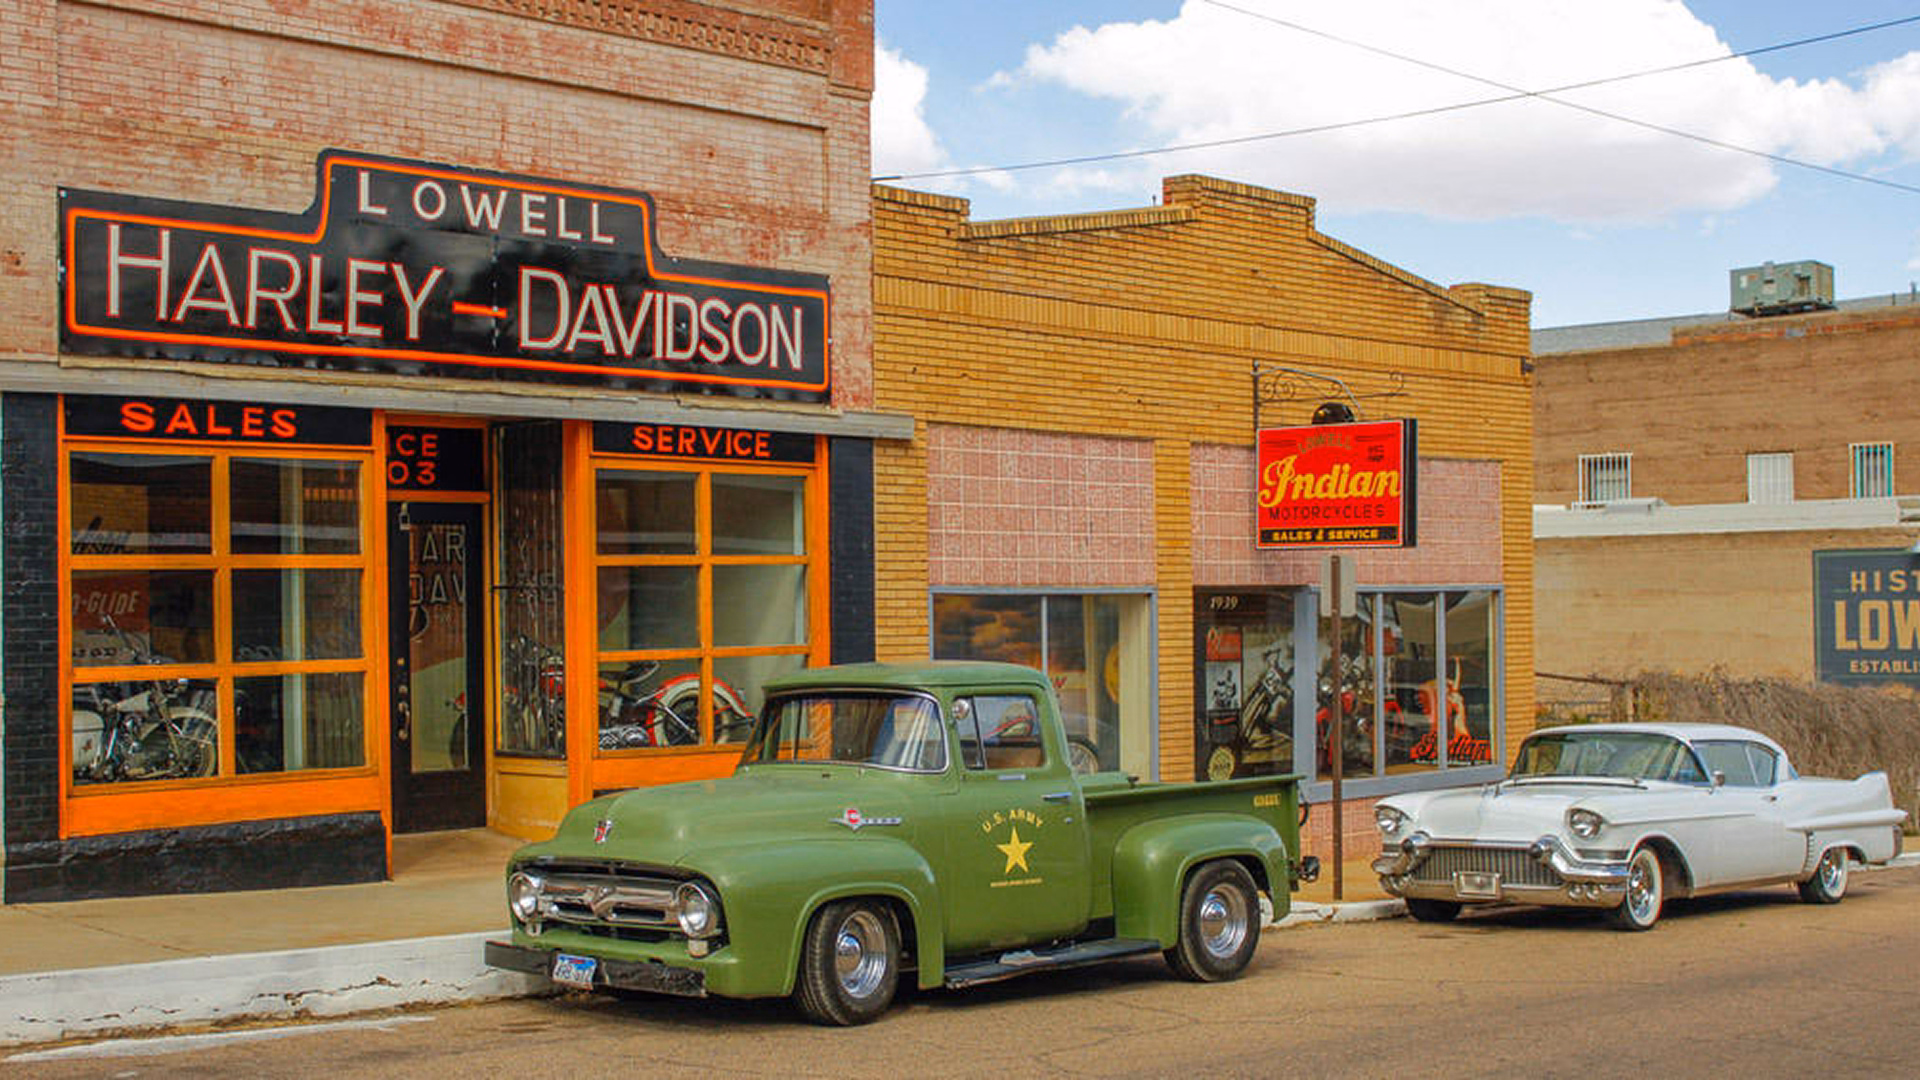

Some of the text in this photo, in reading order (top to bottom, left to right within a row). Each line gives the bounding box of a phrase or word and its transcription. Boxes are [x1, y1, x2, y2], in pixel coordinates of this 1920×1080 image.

[357, 169, 615, 245] LOWELL
[120, 402, 297, 438] SALES
[632, 425, 772, 458] SERVICE
[1258, 454, 1401, 508] Indian
[1268, 504, 1386, 521] MOTORCYCLES
[1271, 530, 1313, 541] SALES
[1327, 528, 1380, 541] SERVICE
[1210, 596, 1239, 610] 1939
[1834, 599, 1920, 651] LOW
[1009, 808, 1044, 828] ARMY
